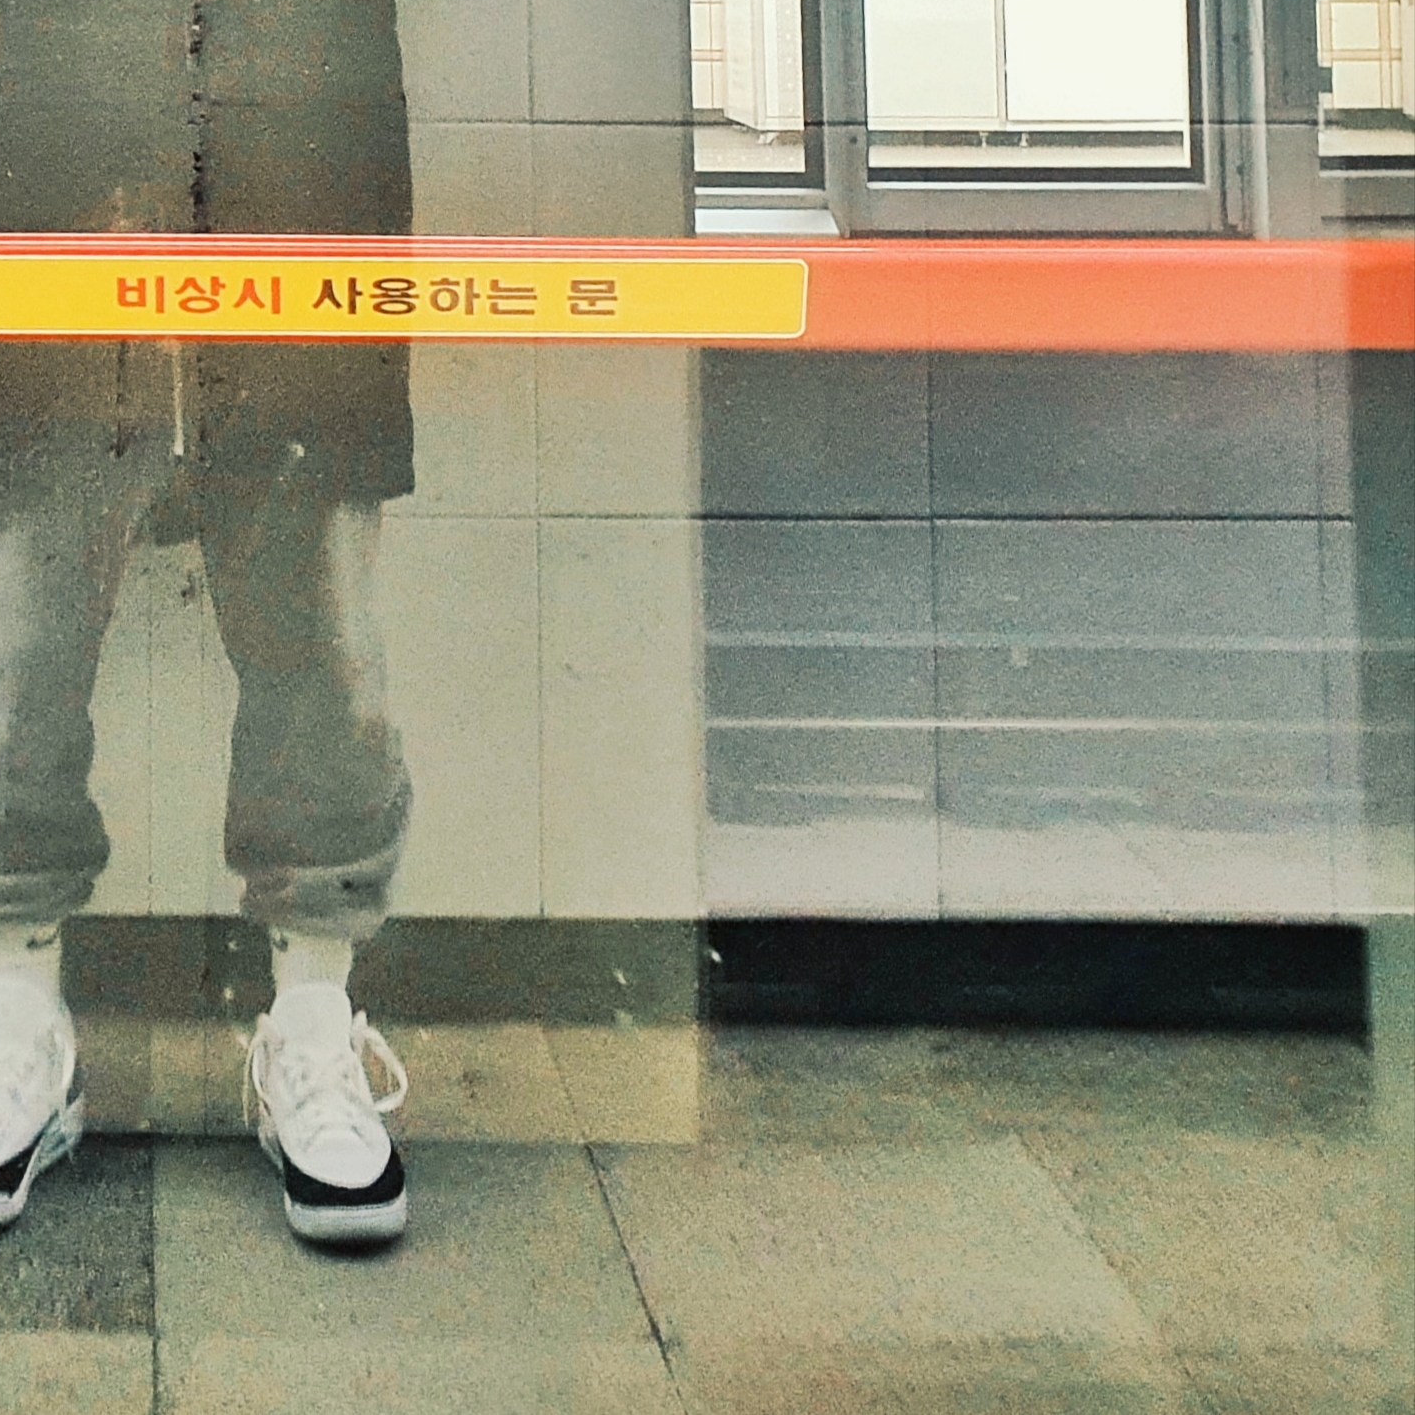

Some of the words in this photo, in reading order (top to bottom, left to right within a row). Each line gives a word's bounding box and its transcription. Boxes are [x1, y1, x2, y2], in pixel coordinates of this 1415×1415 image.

[115, 275, 282, 315] 비상시
[311, 276, 538, 316] 사용하는
[566, 279, 619, 316] 문
